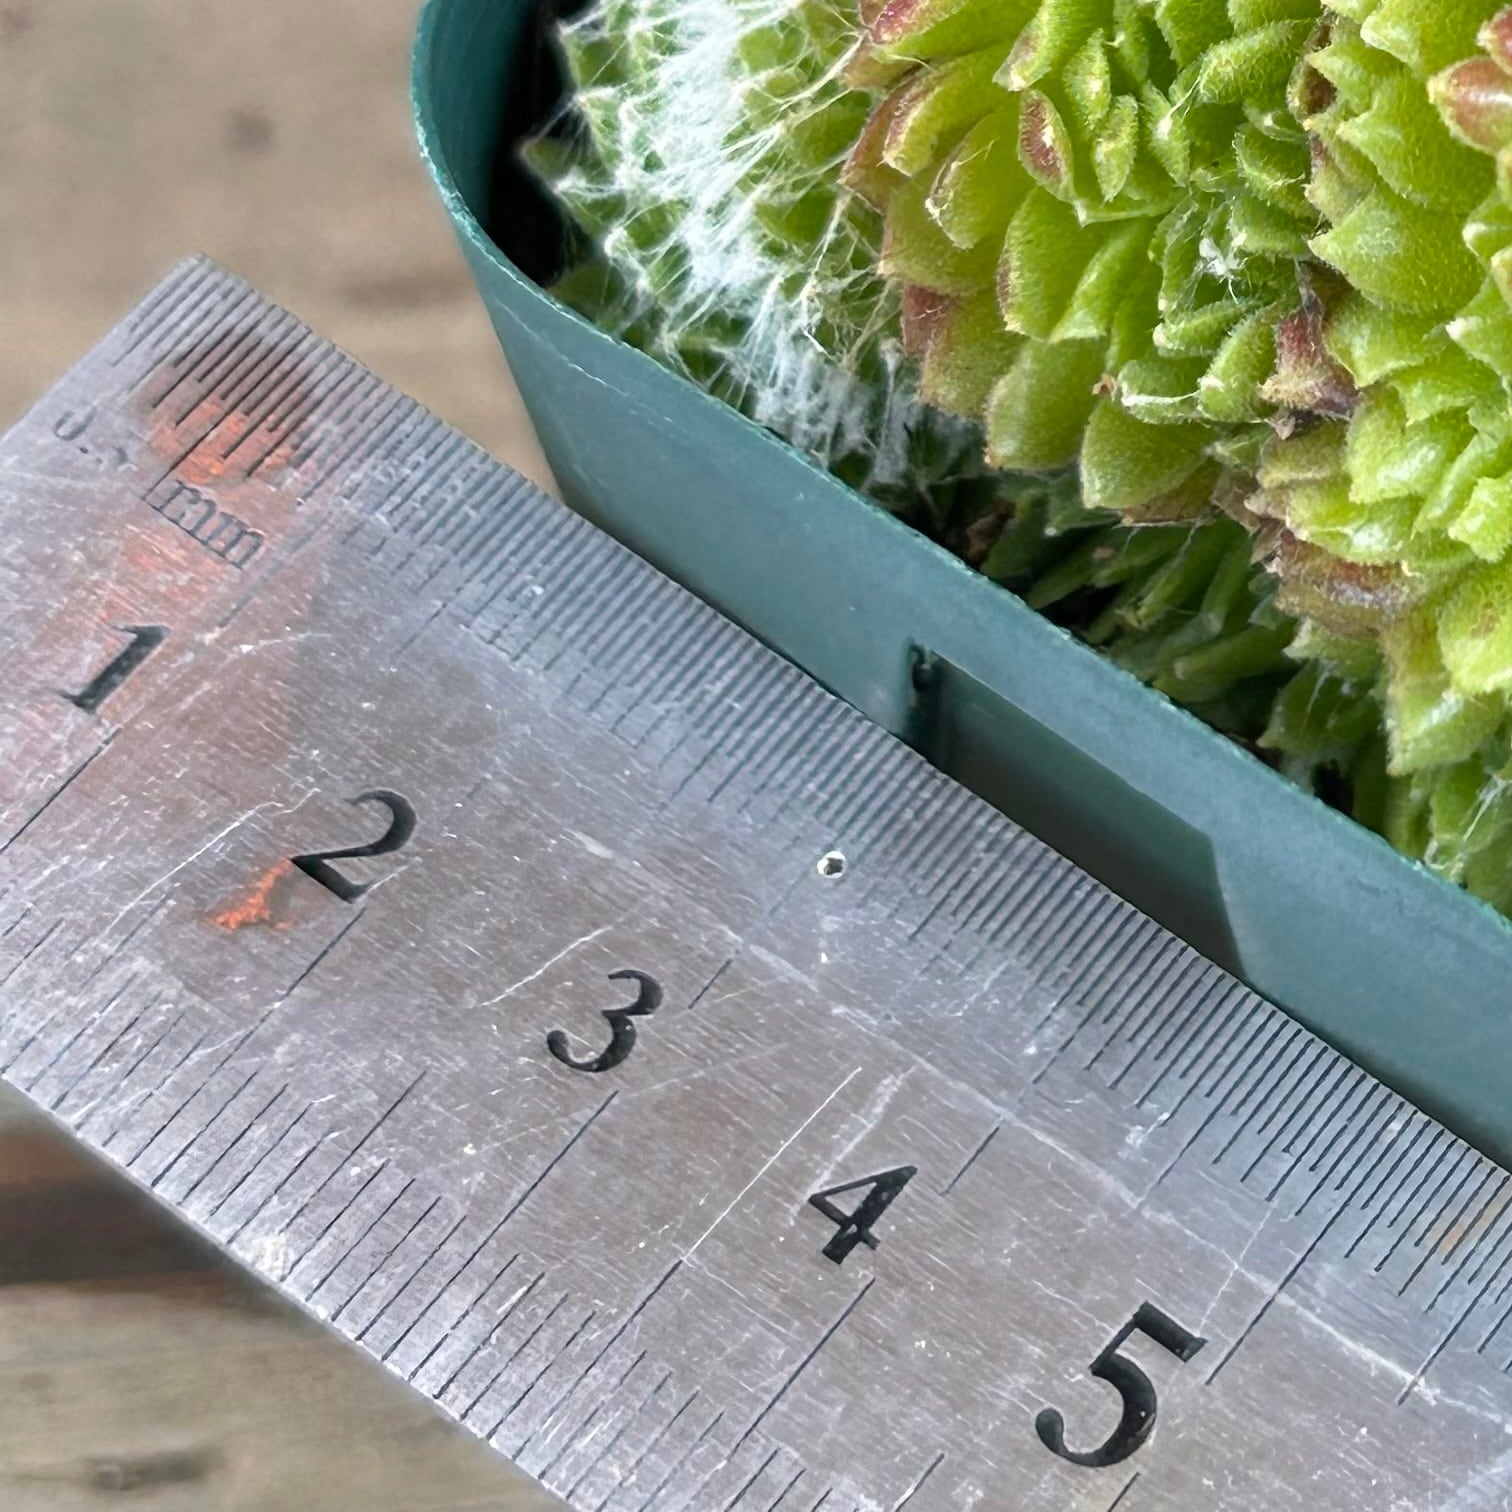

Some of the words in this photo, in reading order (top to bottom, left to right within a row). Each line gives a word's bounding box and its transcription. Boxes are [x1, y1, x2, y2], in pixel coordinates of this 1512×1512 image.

[63, 624, 170, 714] 1
[292, 789, 417, 904] 2
[546, 968, 664, 1073] 3
[808, 1165, 917, 1265] 4
[1035, 1301, 1207, 1467] 5
